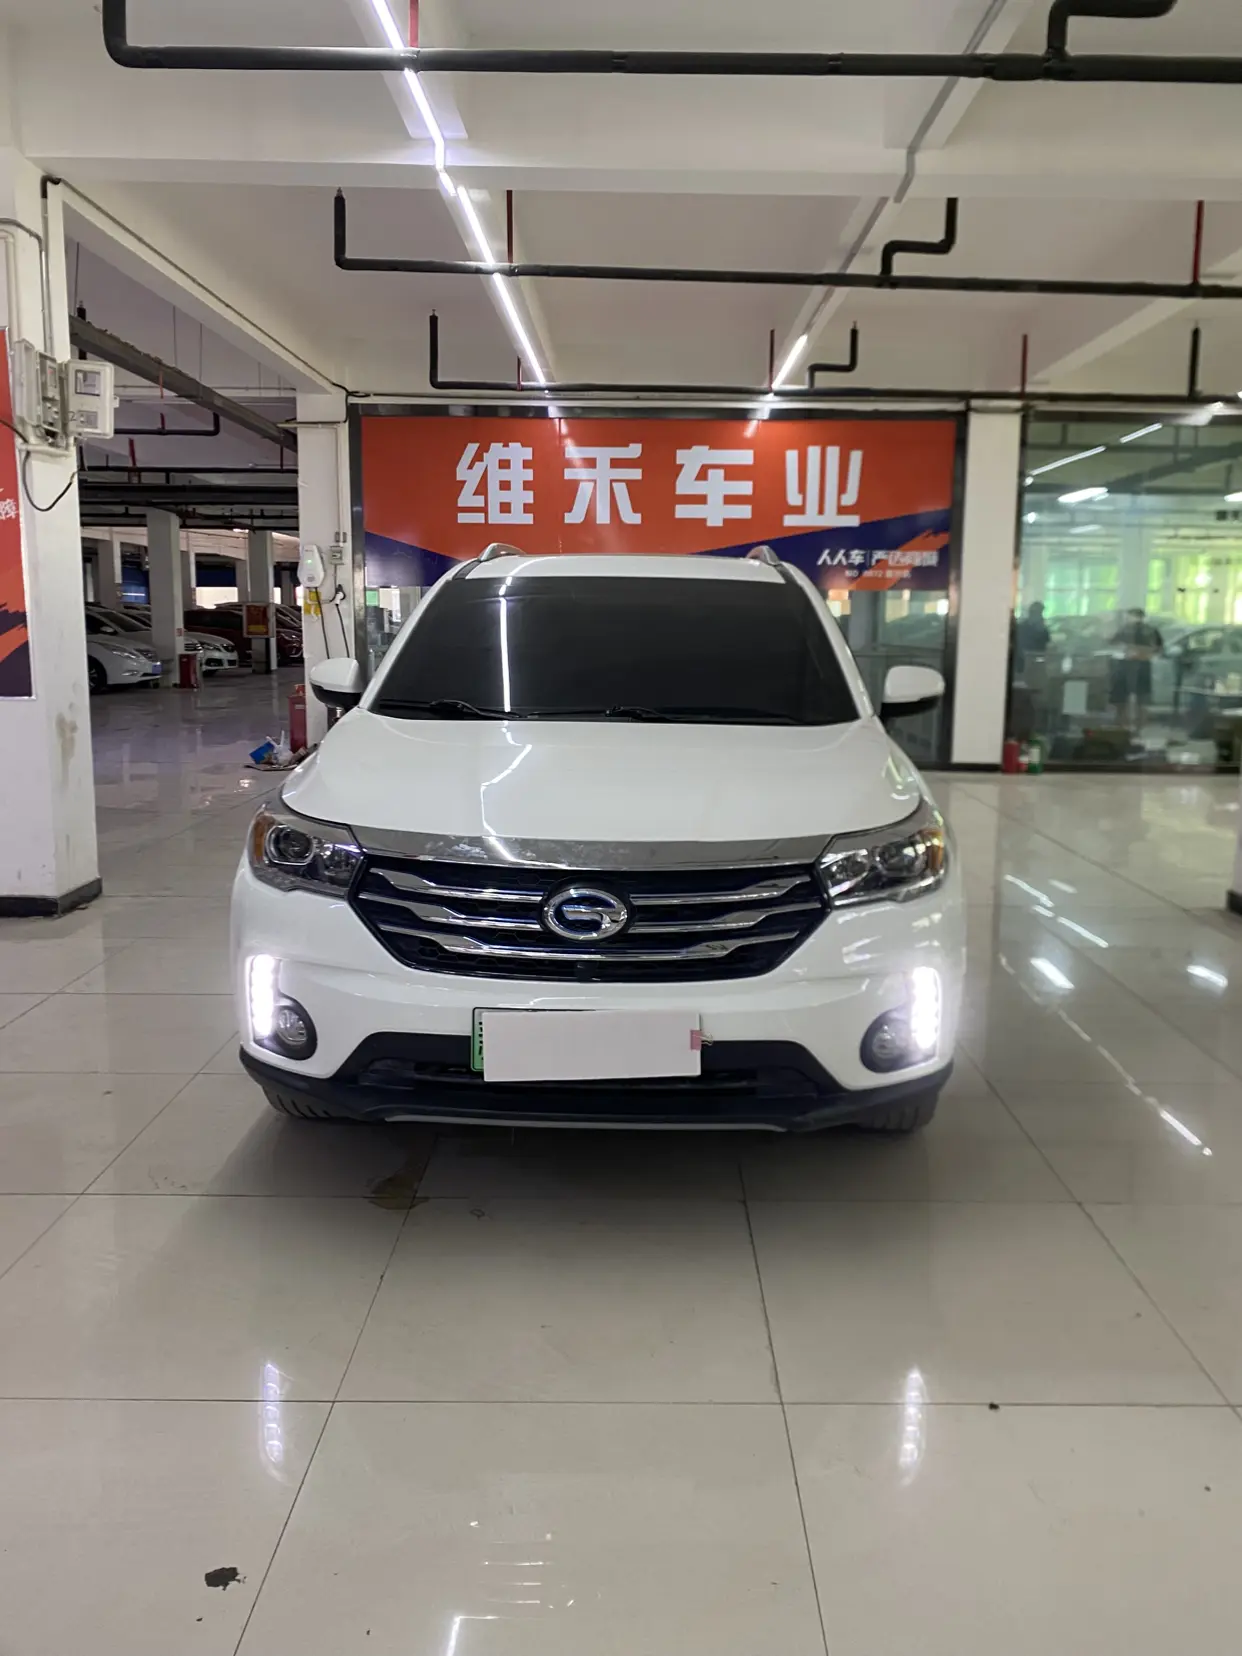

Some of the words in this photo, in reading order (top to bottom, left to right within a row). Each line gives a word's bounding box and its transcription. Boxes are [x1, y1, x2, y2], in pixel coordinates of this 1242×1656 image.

[456, 442, 863, 527] 维禾车业
[817, 548, 865, 566] 人人车
